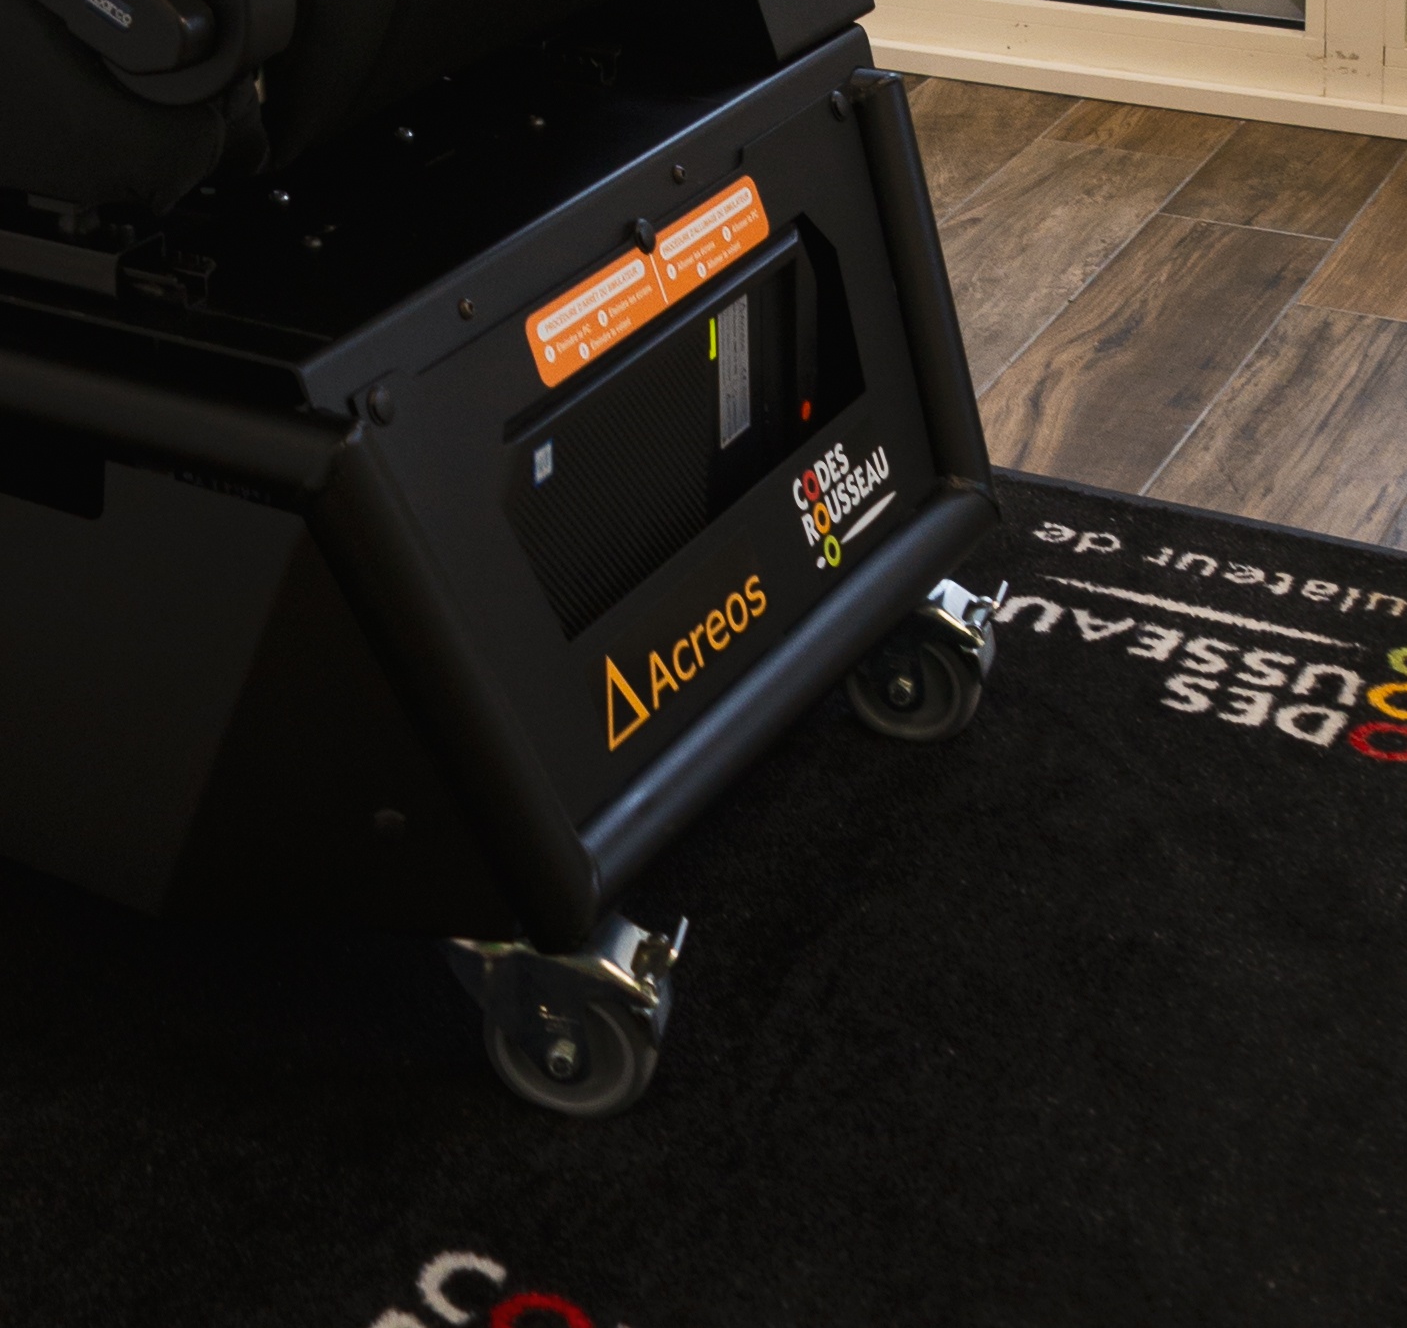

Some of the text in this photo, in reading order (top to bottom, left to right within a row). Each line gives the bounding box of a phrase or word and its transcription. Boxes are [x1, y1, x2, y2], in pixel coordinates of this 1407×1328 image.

[793, 443, 850, 511] CODES
[801, 446, 890, 546] ROUSSEAU
[1033, 521, 1122, 554] de
[649, 574, 768, 710] Acreos
